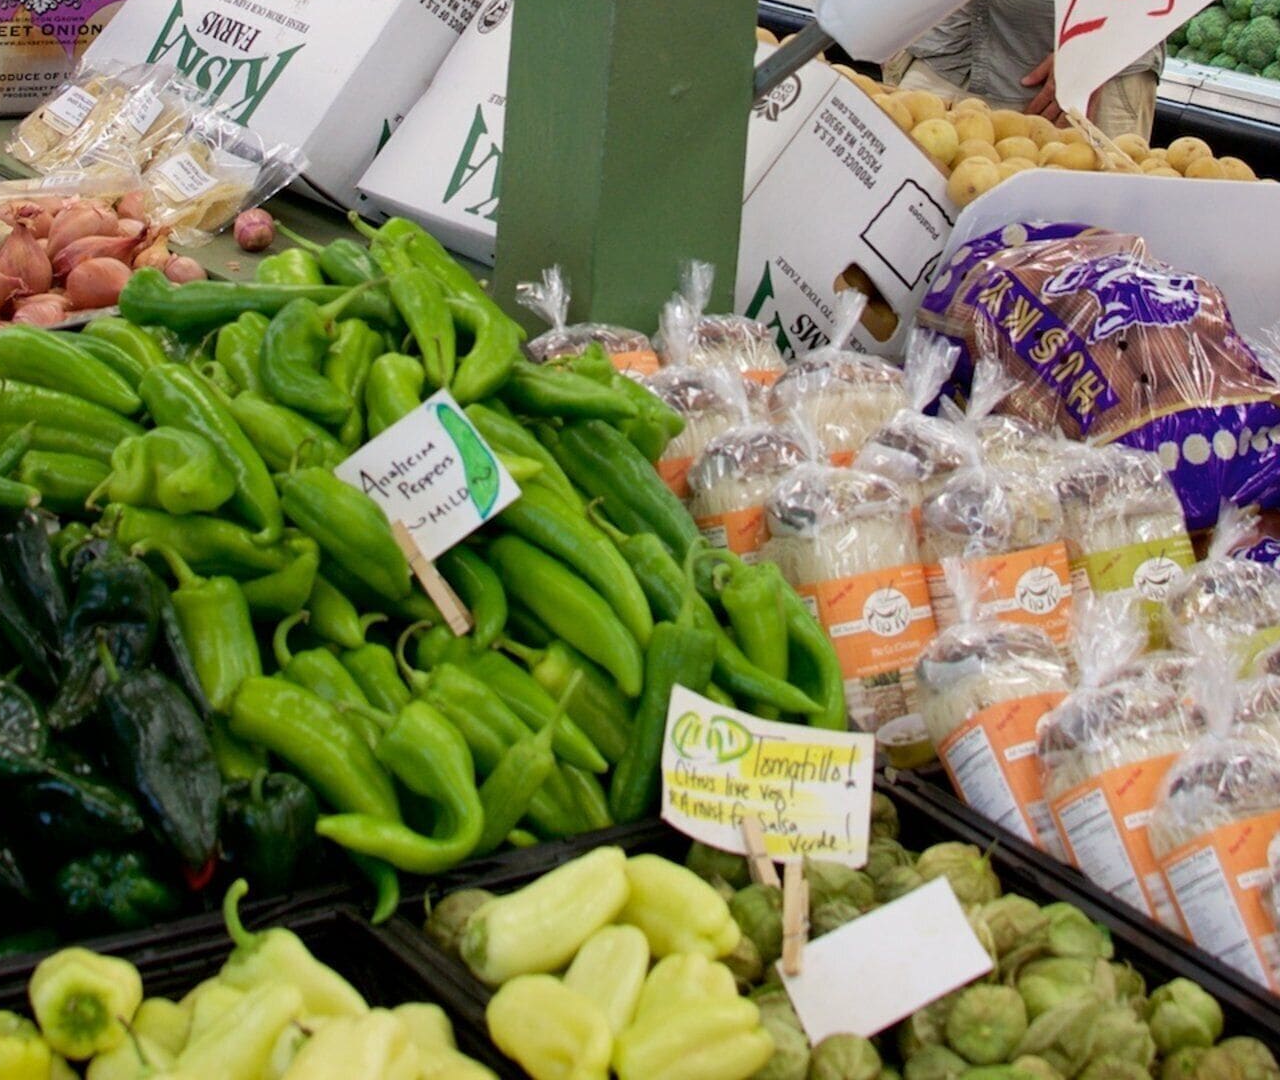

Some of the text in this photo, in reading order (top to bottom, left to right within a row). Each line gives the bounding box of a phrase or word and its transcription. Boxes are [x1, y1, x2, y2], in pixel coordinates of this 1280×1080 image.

[248, 2, 267, 18] OUR
[265, 9, 288, 26] FROM
[195, 7, 263, 54] FARMS
[43, 71, 60, 81] OF
[818, 108, 847, 137] 99302
[831, 143, 846, 157] OF
[841, 131, 858, 148] WA
[841, 152, 878, 190] PRODUCE
[773, 255, 803, 285] TABLE
[797, 281, 824, 307] YOUR
